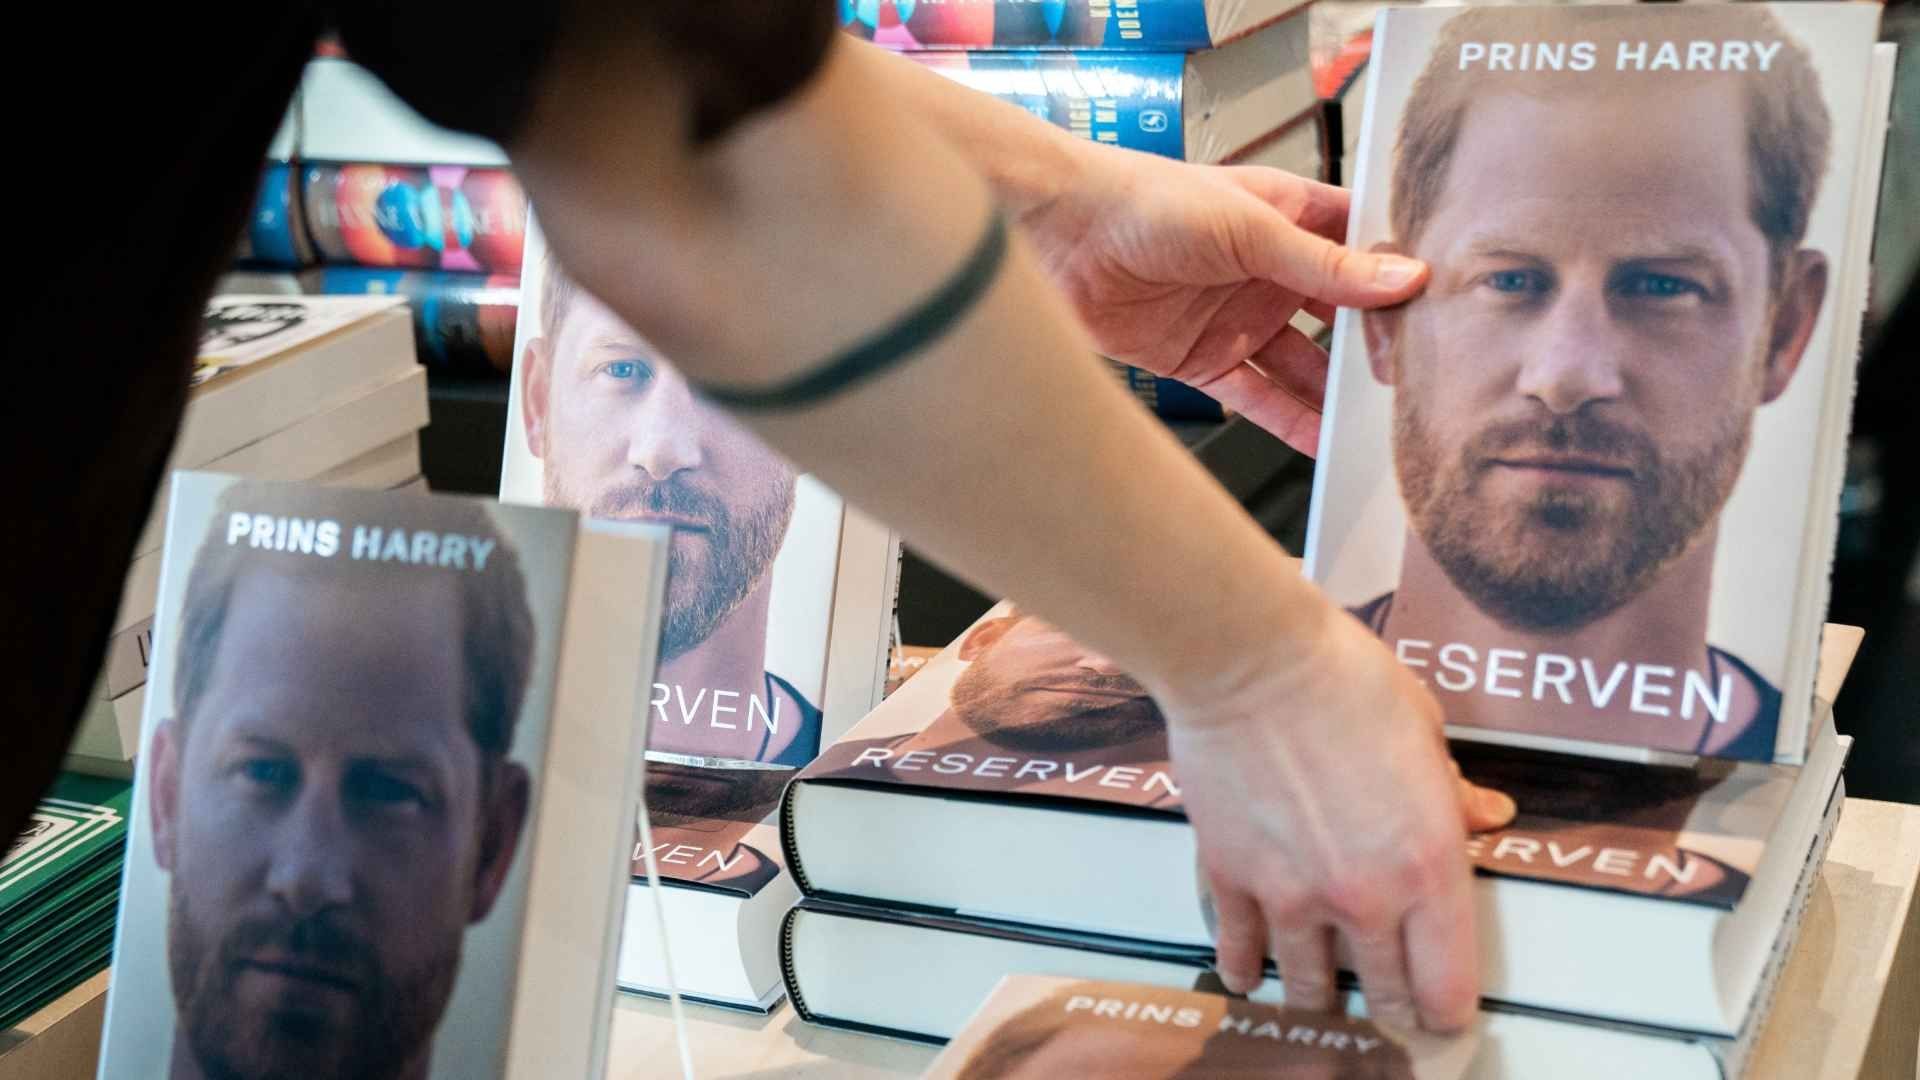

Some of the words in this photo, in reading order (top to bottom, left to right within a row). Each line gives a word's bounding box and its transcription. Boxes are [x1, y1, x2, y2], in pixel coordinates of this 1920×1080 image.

[1458, 41, 1597, 71] PRINS
[1615, 41, 1783, 71] HARRY
[226, 511, 341, 558] PRINS
[351, 525, 496, 572] HARRY
[651, 683, 781, 734] RVEN
[1396, 639, 1733, 723] ESERVEN
[850, 747, 1182, 796] RESERVEN
[1065, 996, 1203, 1028] PRINS
[1219, 1014, 1379, 1055] HARRY
